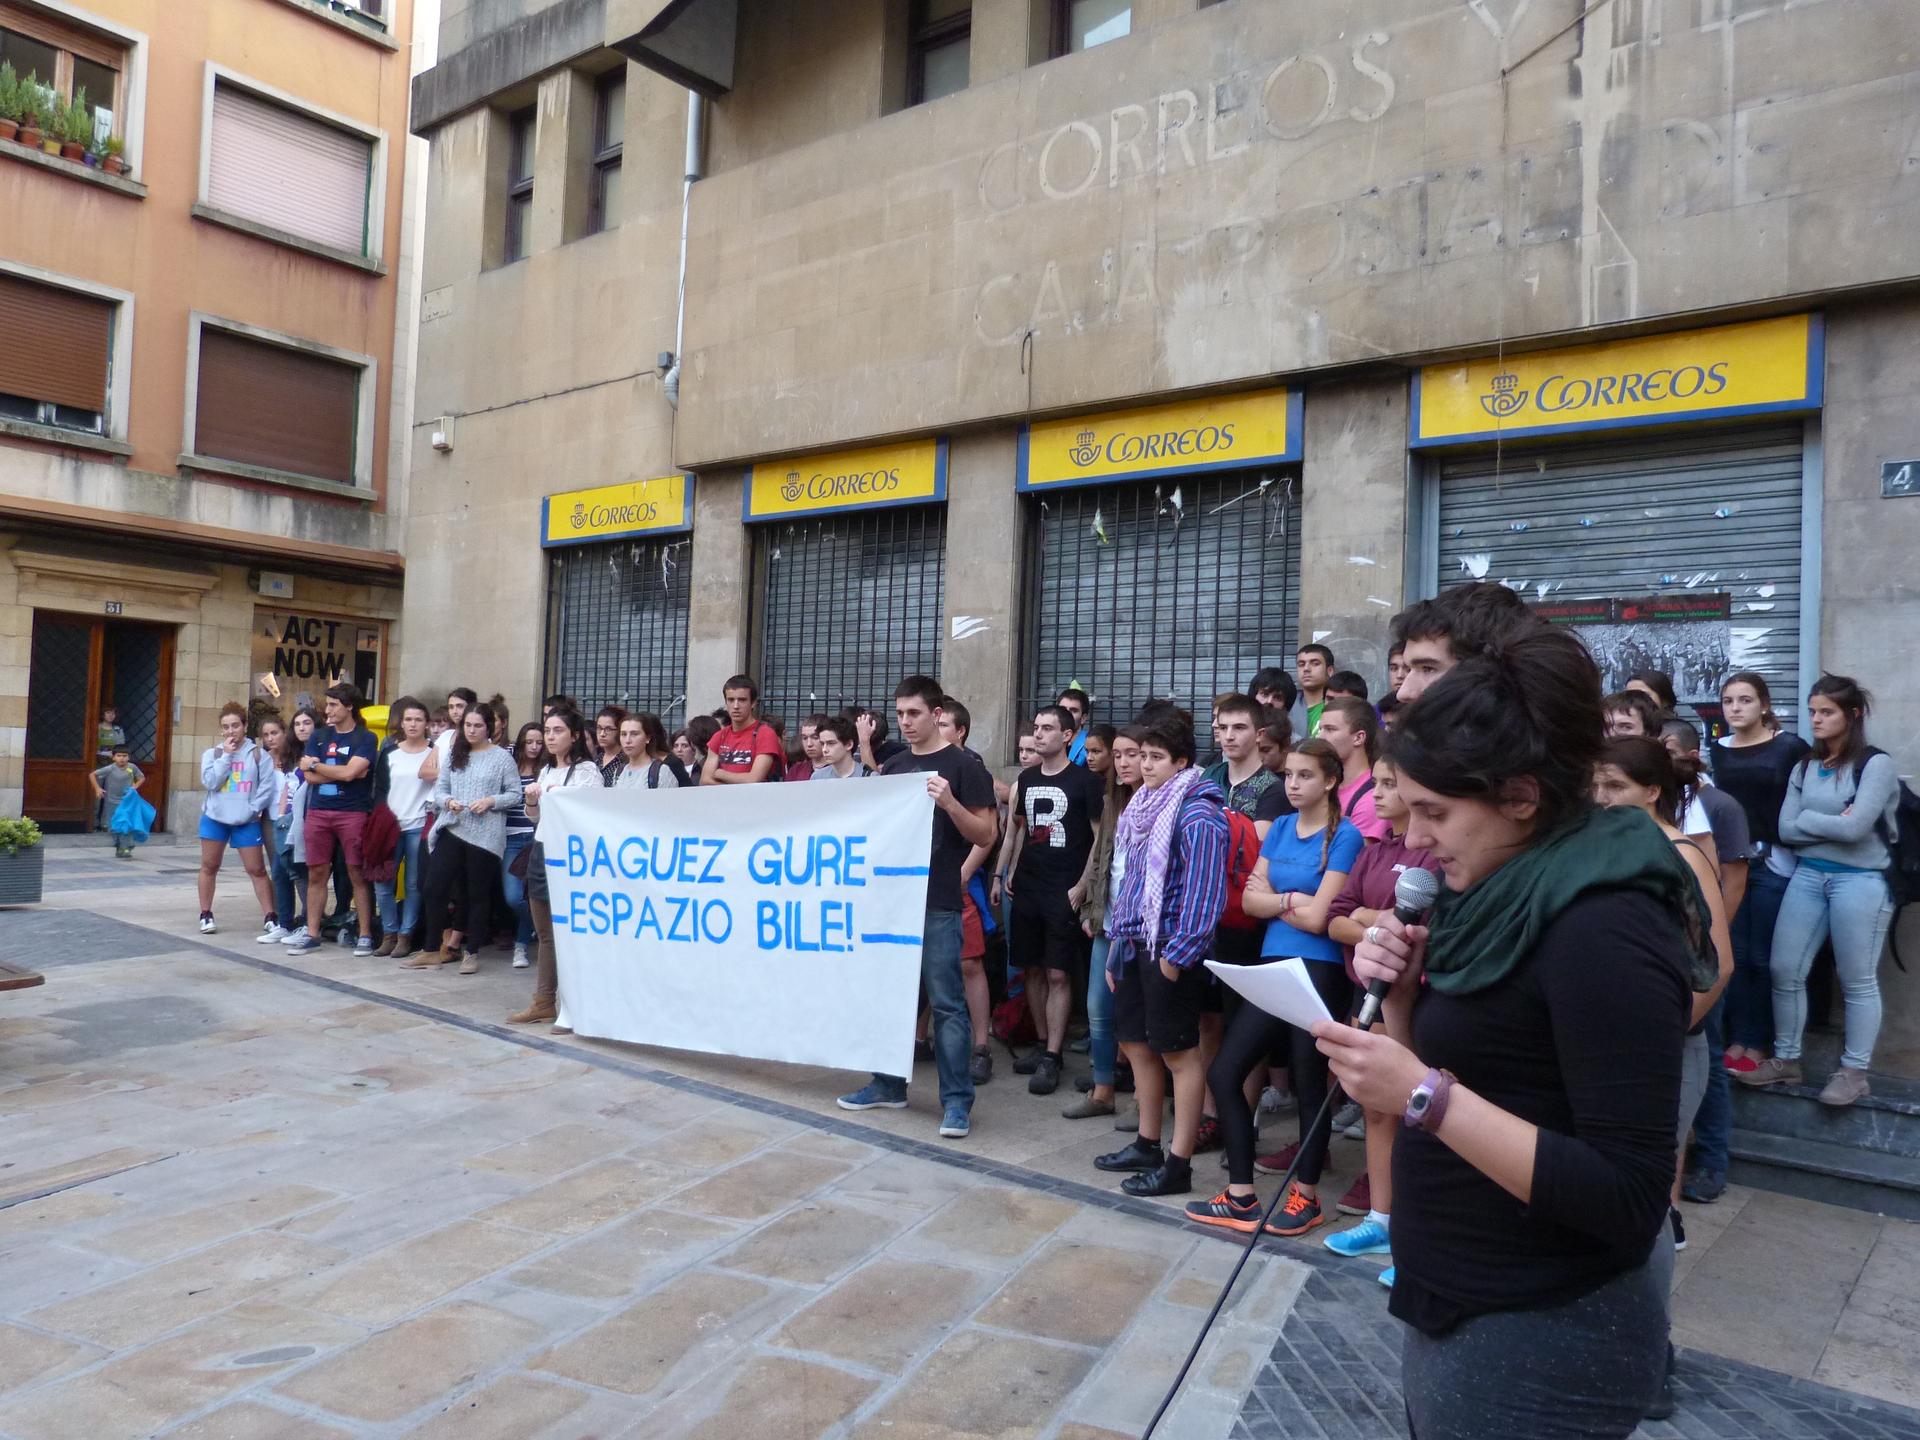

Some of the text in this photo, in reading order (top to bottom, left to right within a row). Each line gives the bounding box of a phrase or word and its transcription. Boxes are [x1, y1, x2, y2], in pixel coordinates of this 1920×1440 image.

[977, 32, 1396, 213] CORREOS
[973, 239, 1161, 346] CAJA
[1535, 362, 1729, 412] CORREOS
[1105, 423, 1235, 463] CORREOS
[807, 467, 900, 500] CORREOS
[590, 501, 658, 527] CORREOS
[107, 602, 121, 614] 31
[281, 615, 342, 649] ACT
[274, 647, 345, 681] NOW
[1024, 785, 1069, 849] R
[567, 834, 867, 887] BAGUEZ GURE
[570, 891, 854, 953] ESPAZIO BILE!
